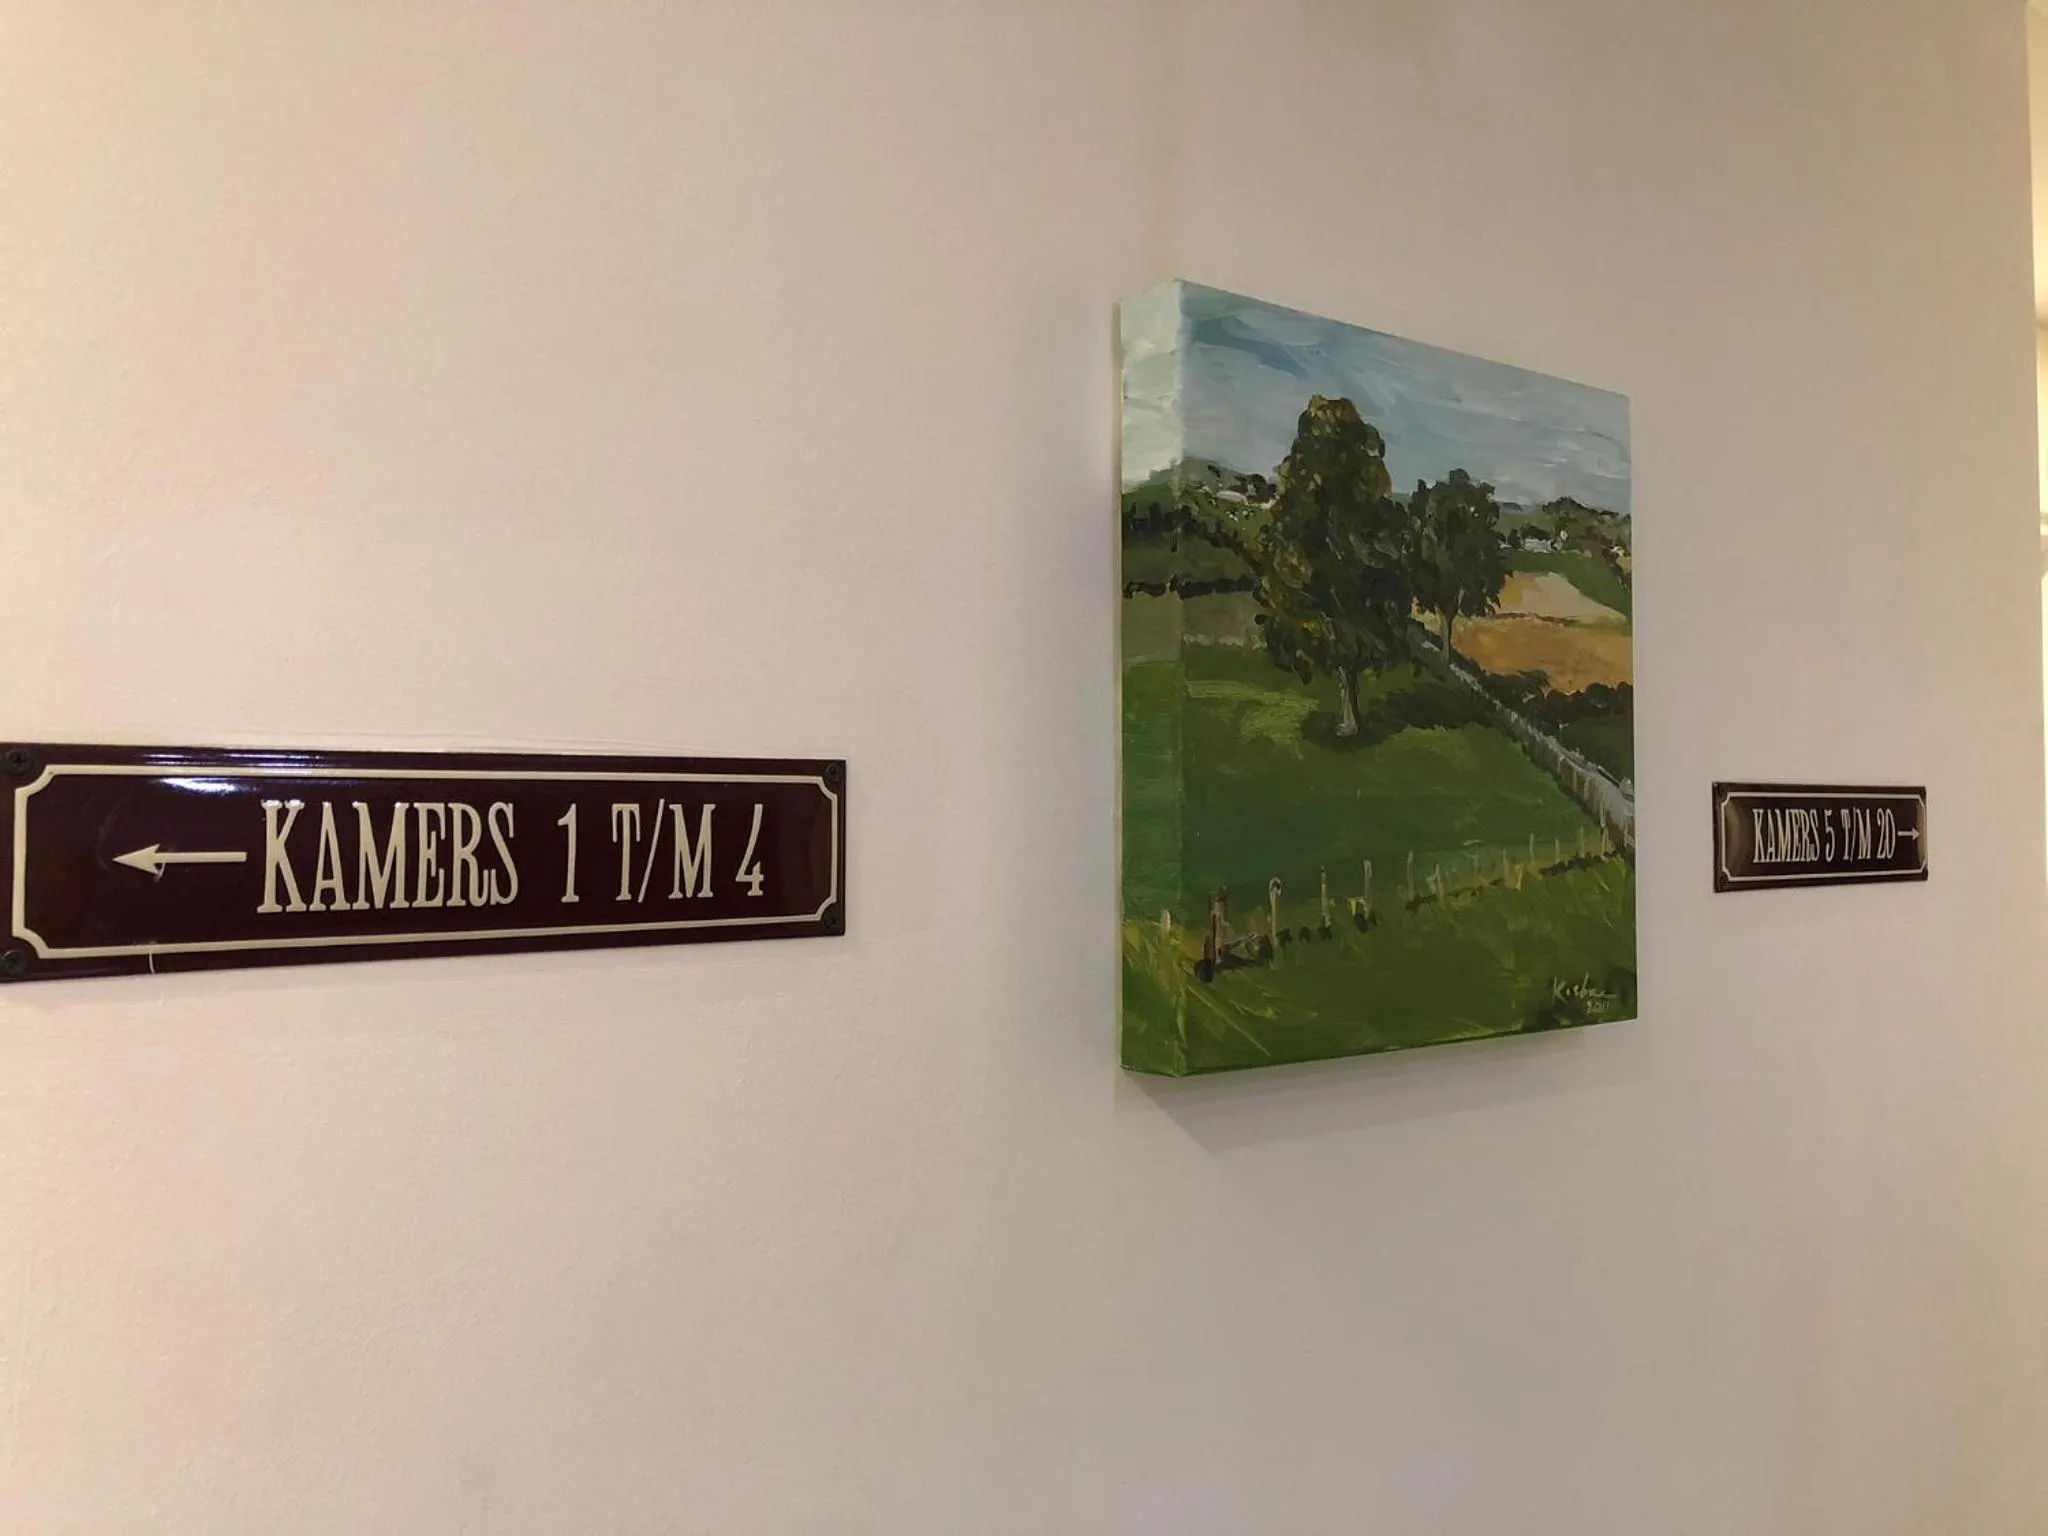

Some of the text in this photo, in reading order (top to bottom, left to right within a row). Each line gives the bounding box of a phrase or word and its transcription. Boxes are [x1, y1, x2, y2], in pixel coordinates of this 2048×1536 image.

[257, 798, 764, 914] KAMERS 1 T/M 4
[1752, 806, 1896, 863] KAMERS 5 T/M 20
